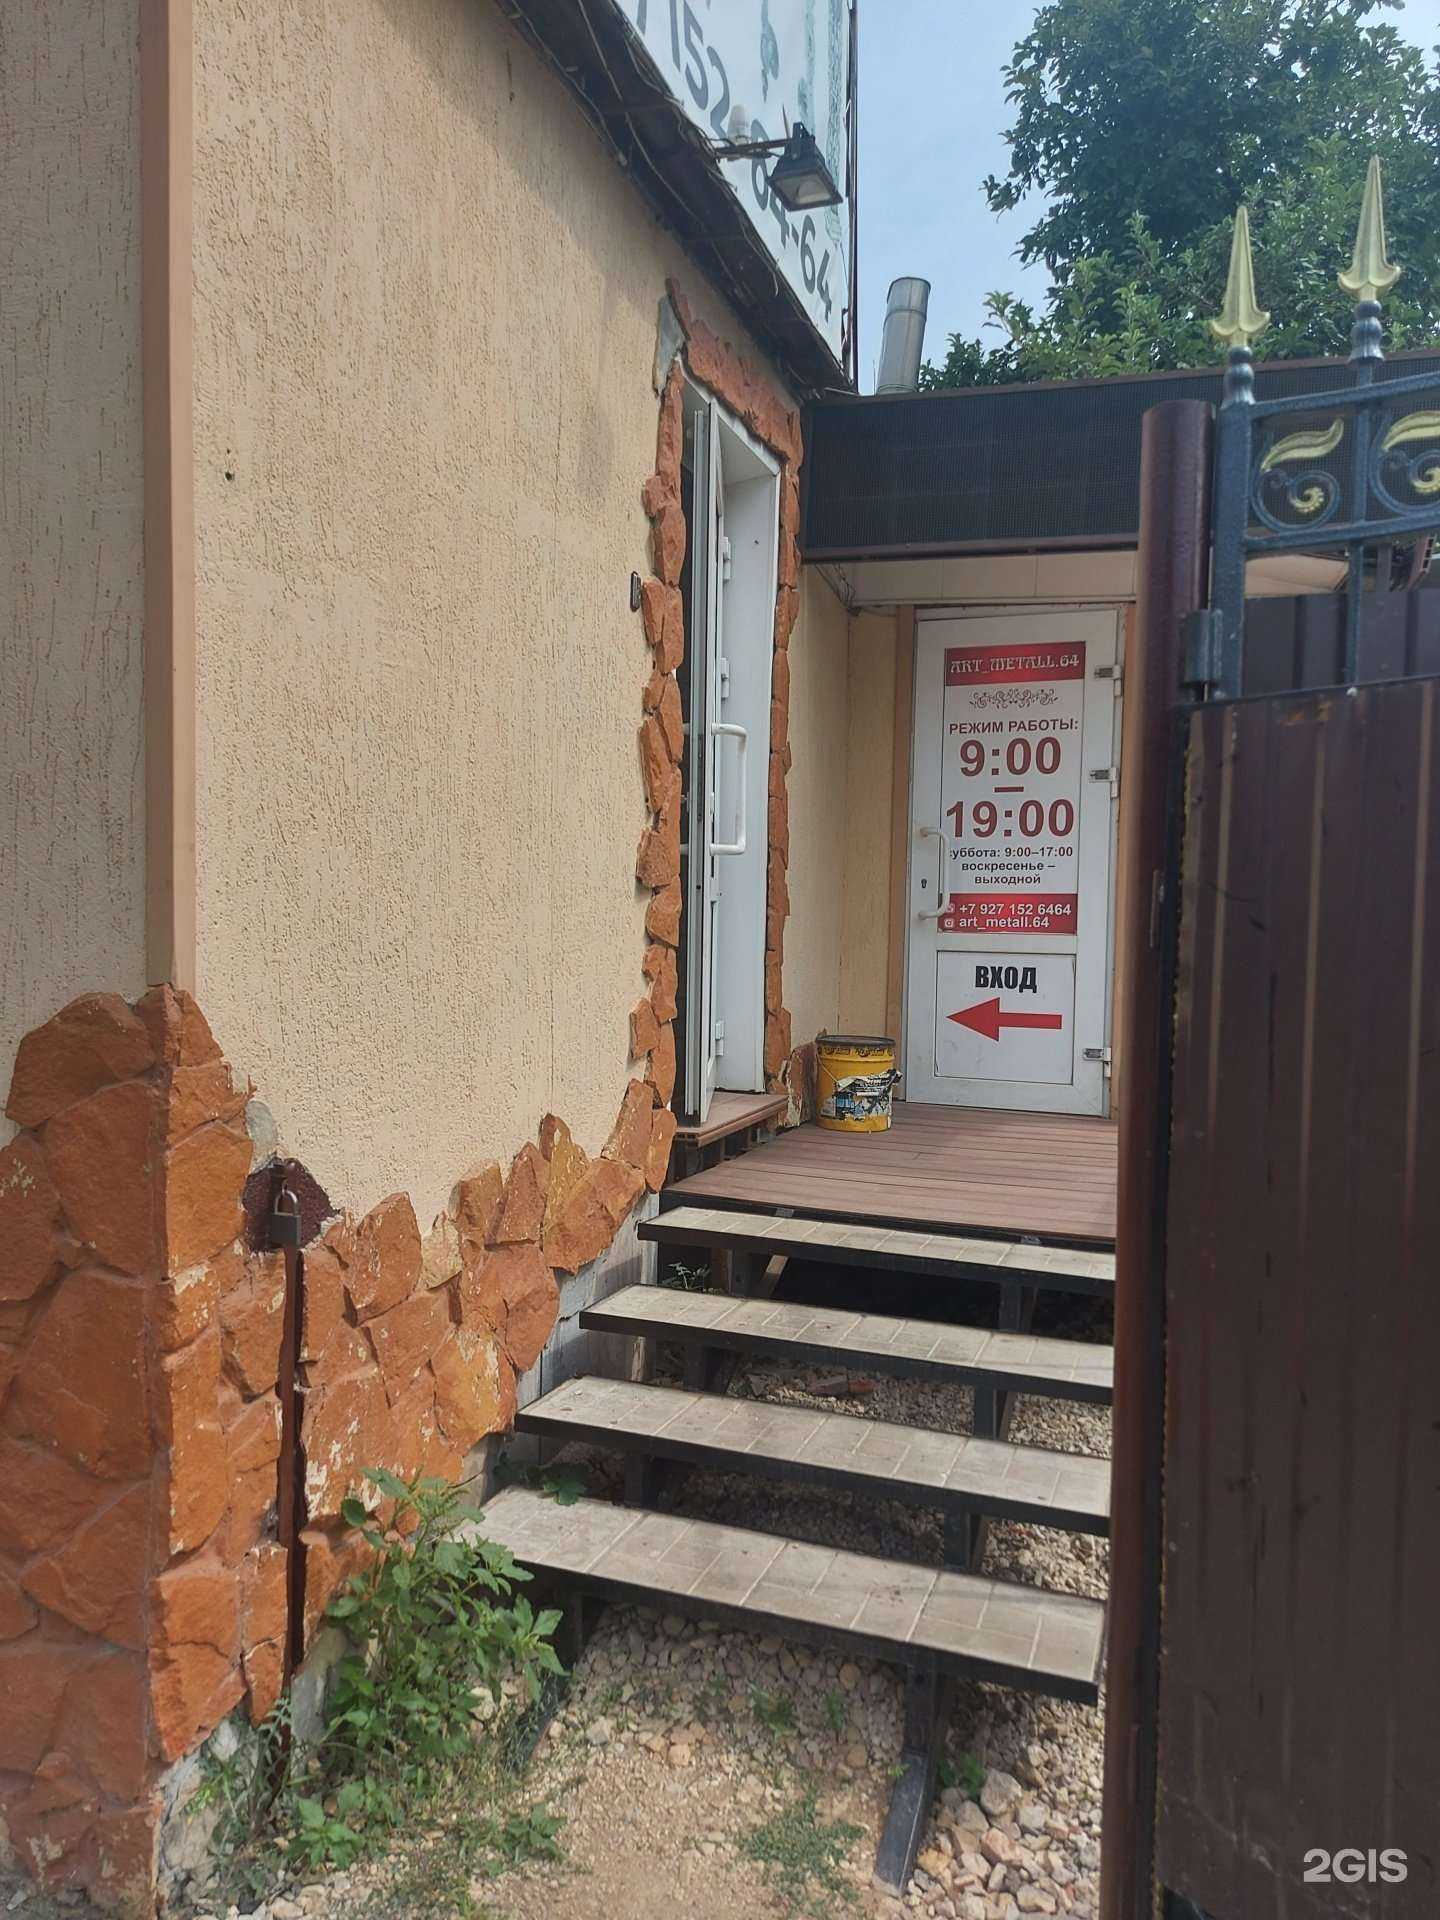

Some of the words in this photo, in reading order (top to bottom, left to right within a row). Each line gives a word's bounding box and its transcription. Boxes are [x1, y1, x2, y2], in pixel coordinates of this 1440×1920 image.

[950, 654, 1079, 674] ART_METALL.64
[949, 721, 1003, 735] РЕЖИМ
[1008, 718, 1078, 733] РАБОТЫ:
[960, 736, 1061, 777] 9:00
[946, 799, 1074, 838] 19:00
[961, 861, 1044, 873] воскресенье
[974, 874, 1041, 886] выходной
[960, 904, 976, 915] +7
[980, 904, 1004, 915] 927
[1009, 904, 1033, 915] 152
[1038, 903, 1071, 916] 6464
[960, 917, 1050, 930] art_metall.64
[975, 965, 1037, 994] ВХОД
